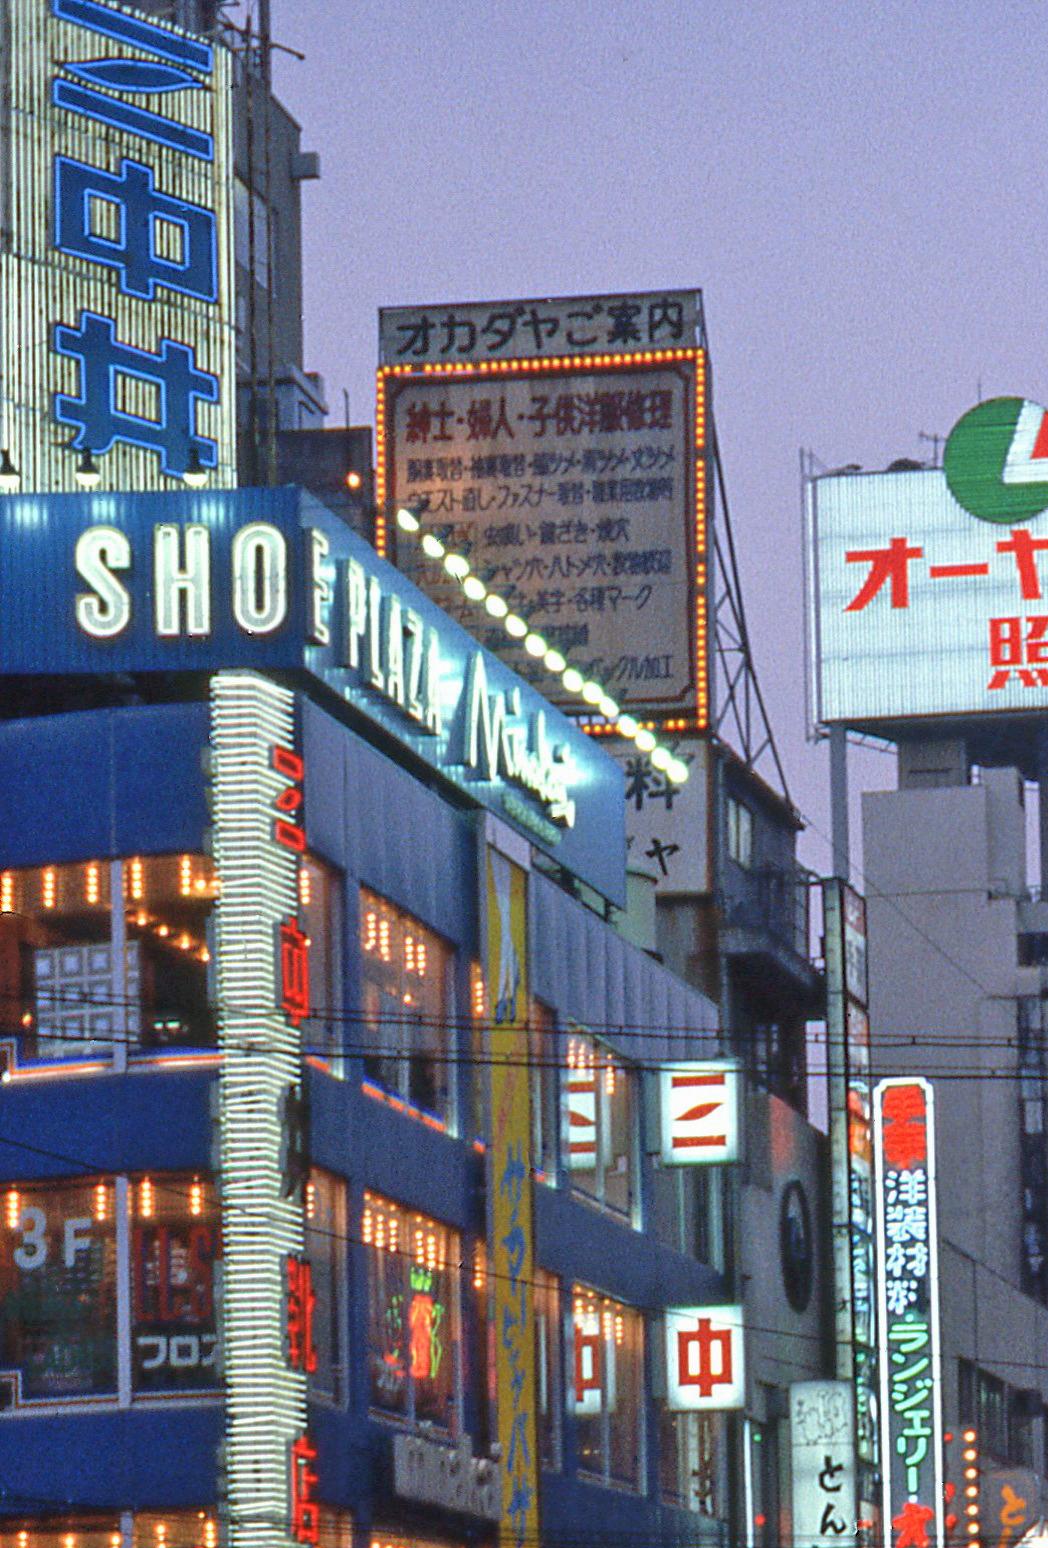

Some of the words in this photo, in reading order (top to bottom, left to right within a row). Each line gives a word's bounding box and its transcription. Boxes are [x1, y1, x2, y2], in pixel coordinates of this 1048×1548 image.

[397, 299, 686, 356] オカダヤご案内
